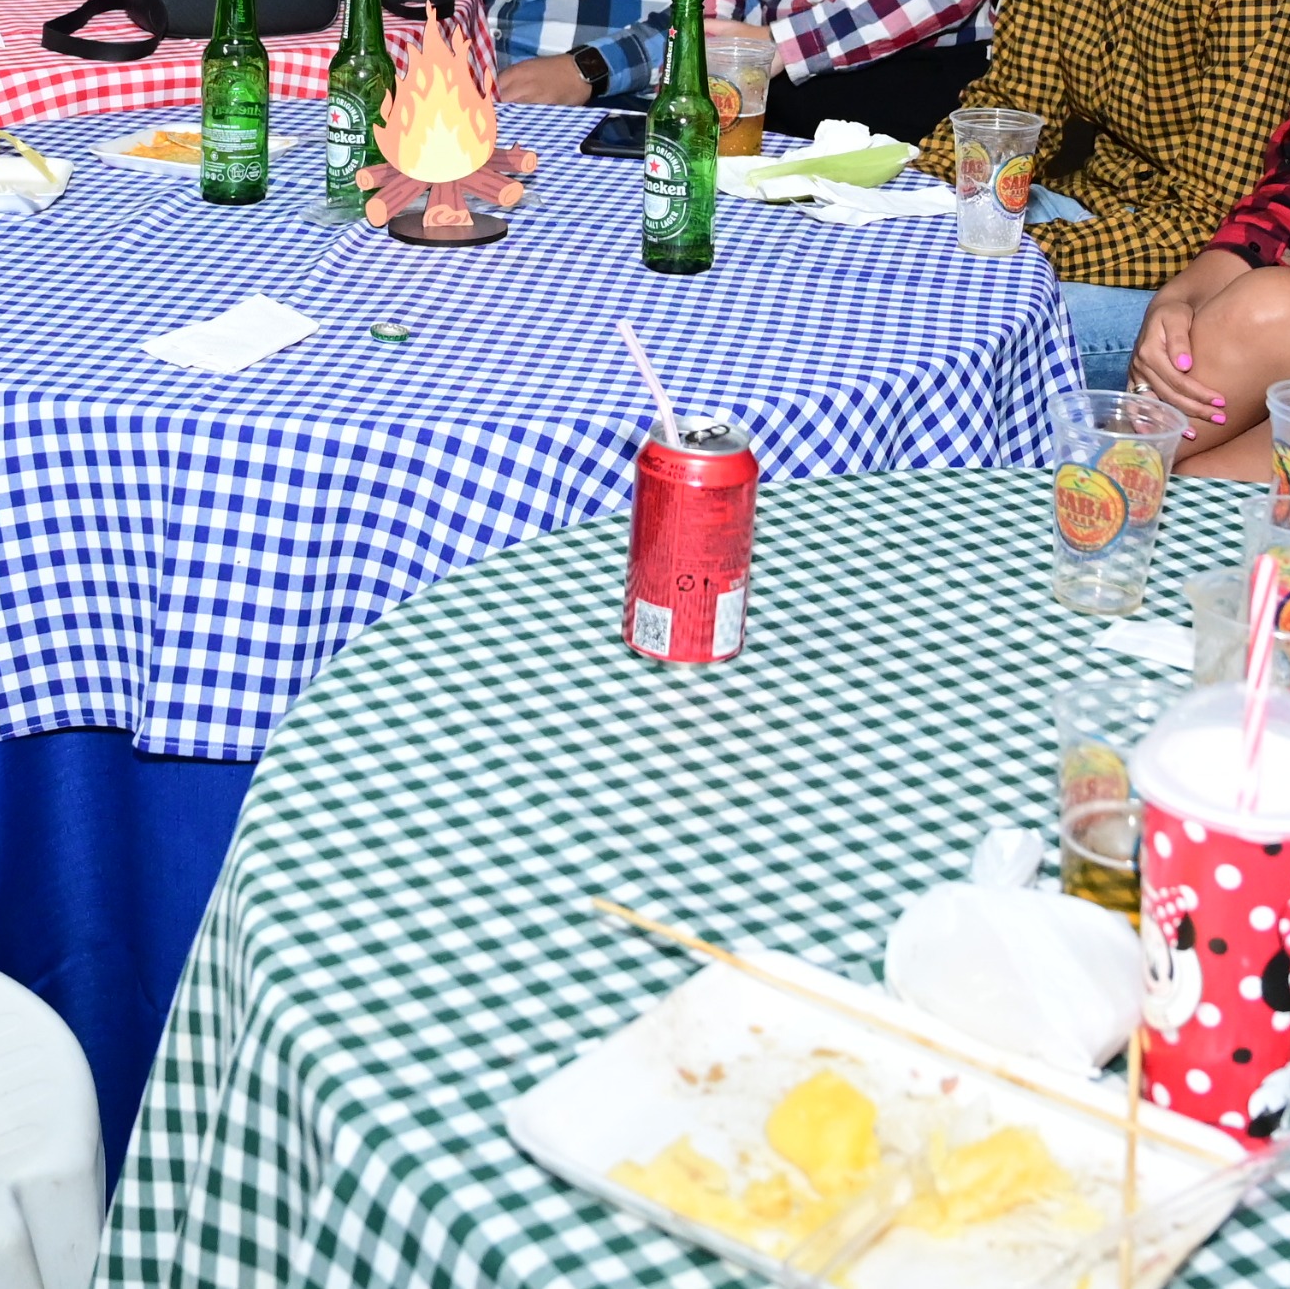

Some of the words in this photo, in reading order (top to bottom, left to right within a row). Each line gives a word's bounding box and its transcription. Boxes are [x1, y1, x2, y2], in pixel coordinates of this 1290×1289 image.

[663, 40, 674, 85] Heineken
[655, 145, 682, 174] ORIGINAL
[660, 210, 679, 229] LAGER
[1057, 486, 1113, 522] SABA
